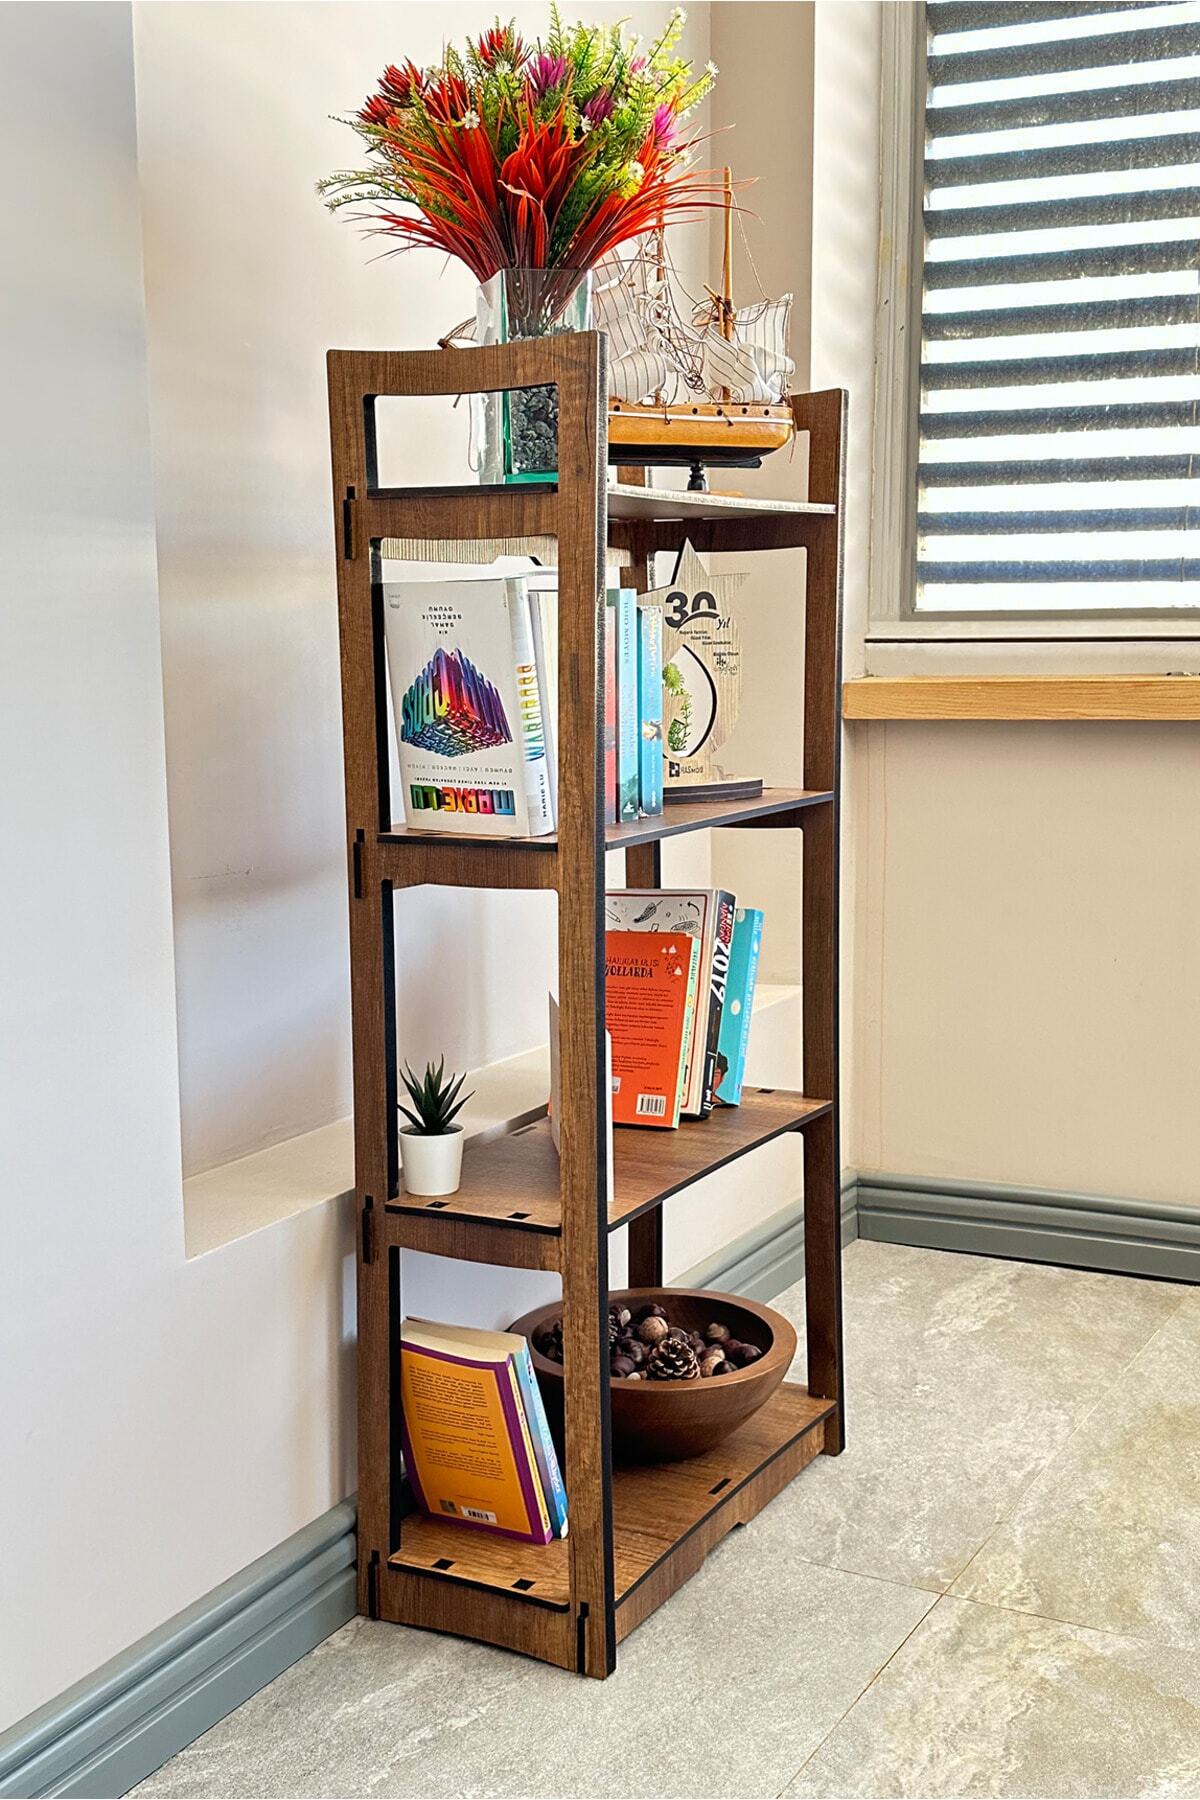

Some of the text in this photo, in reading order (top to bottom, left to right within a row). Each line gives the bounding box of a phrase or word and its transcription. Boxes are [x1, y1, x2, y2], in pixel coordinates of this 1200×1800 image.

[664, 591, 720, 632] 30
[409, 784, 516, 816] MARIE LU
[711, 937, 731, 1004] 2019
